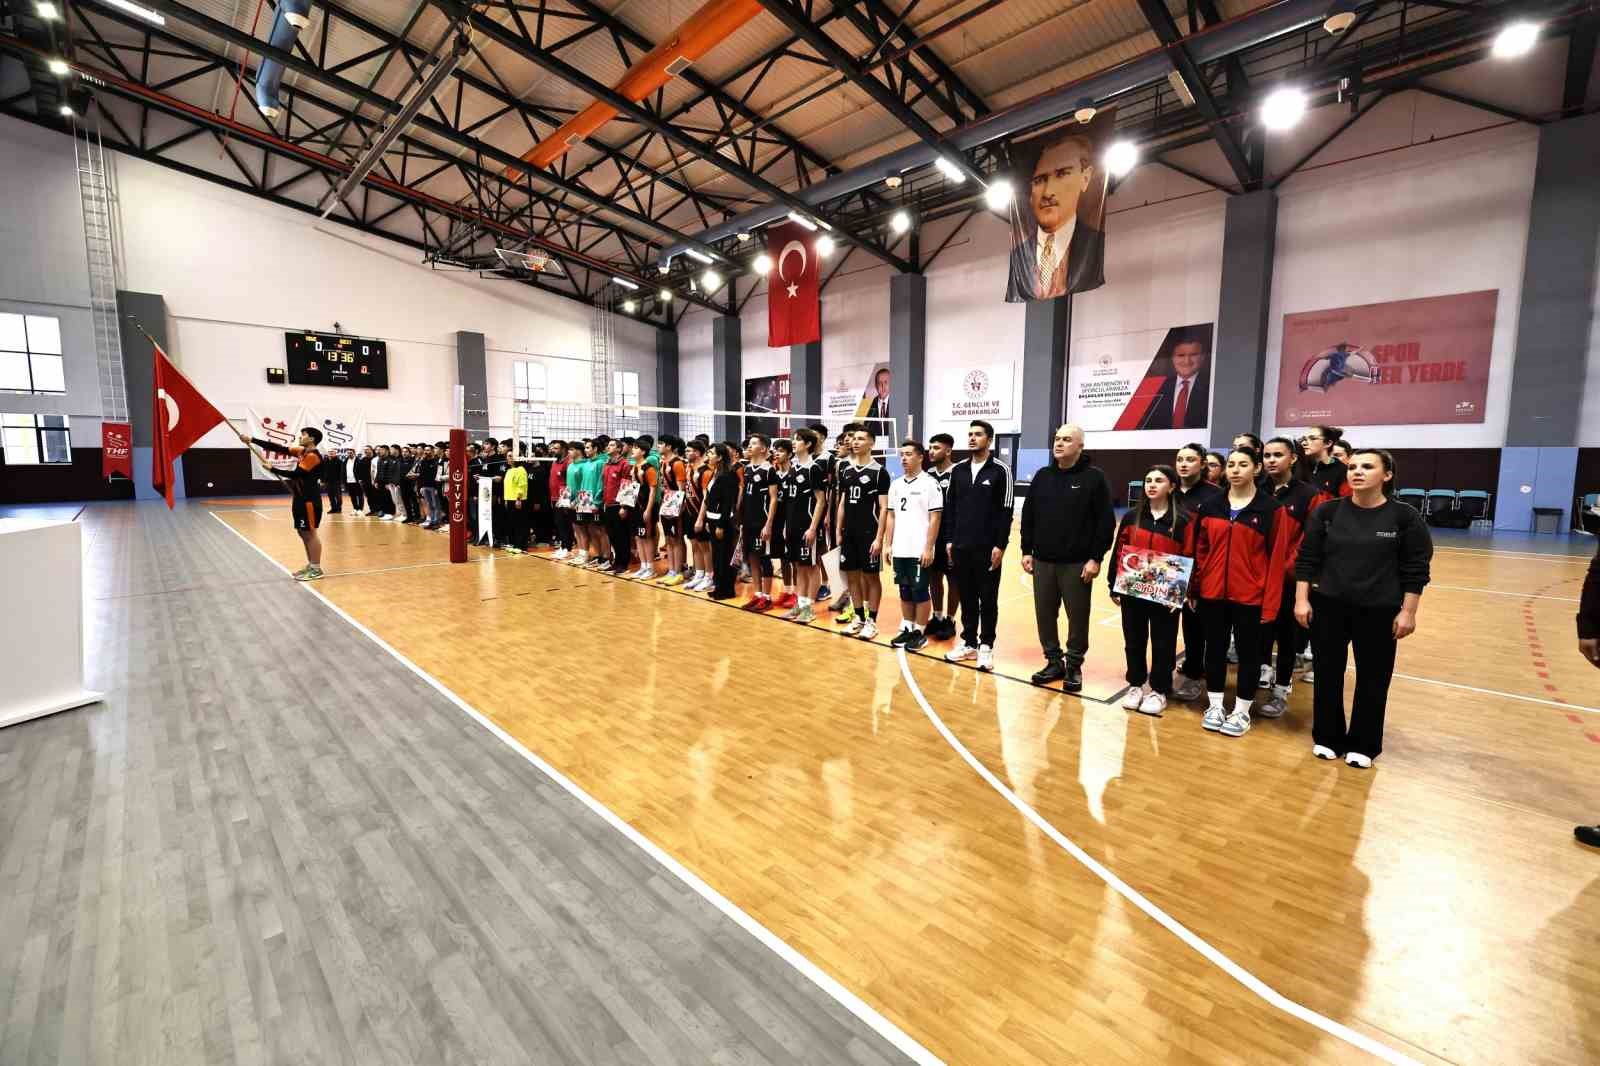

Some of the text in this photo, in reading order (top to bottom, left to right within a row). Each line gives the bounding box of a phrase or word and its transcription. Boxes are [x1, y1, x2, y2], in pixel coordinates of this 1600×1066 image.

[315, 341, 322, 351] 0
[362, 346, 369, 355] 0
[1408, 362, 1466, 382] YERDE
[849, 486, 861, 499] 10
[900, 497, 907, 511] 2
[800, 547, 810, 556] 13
